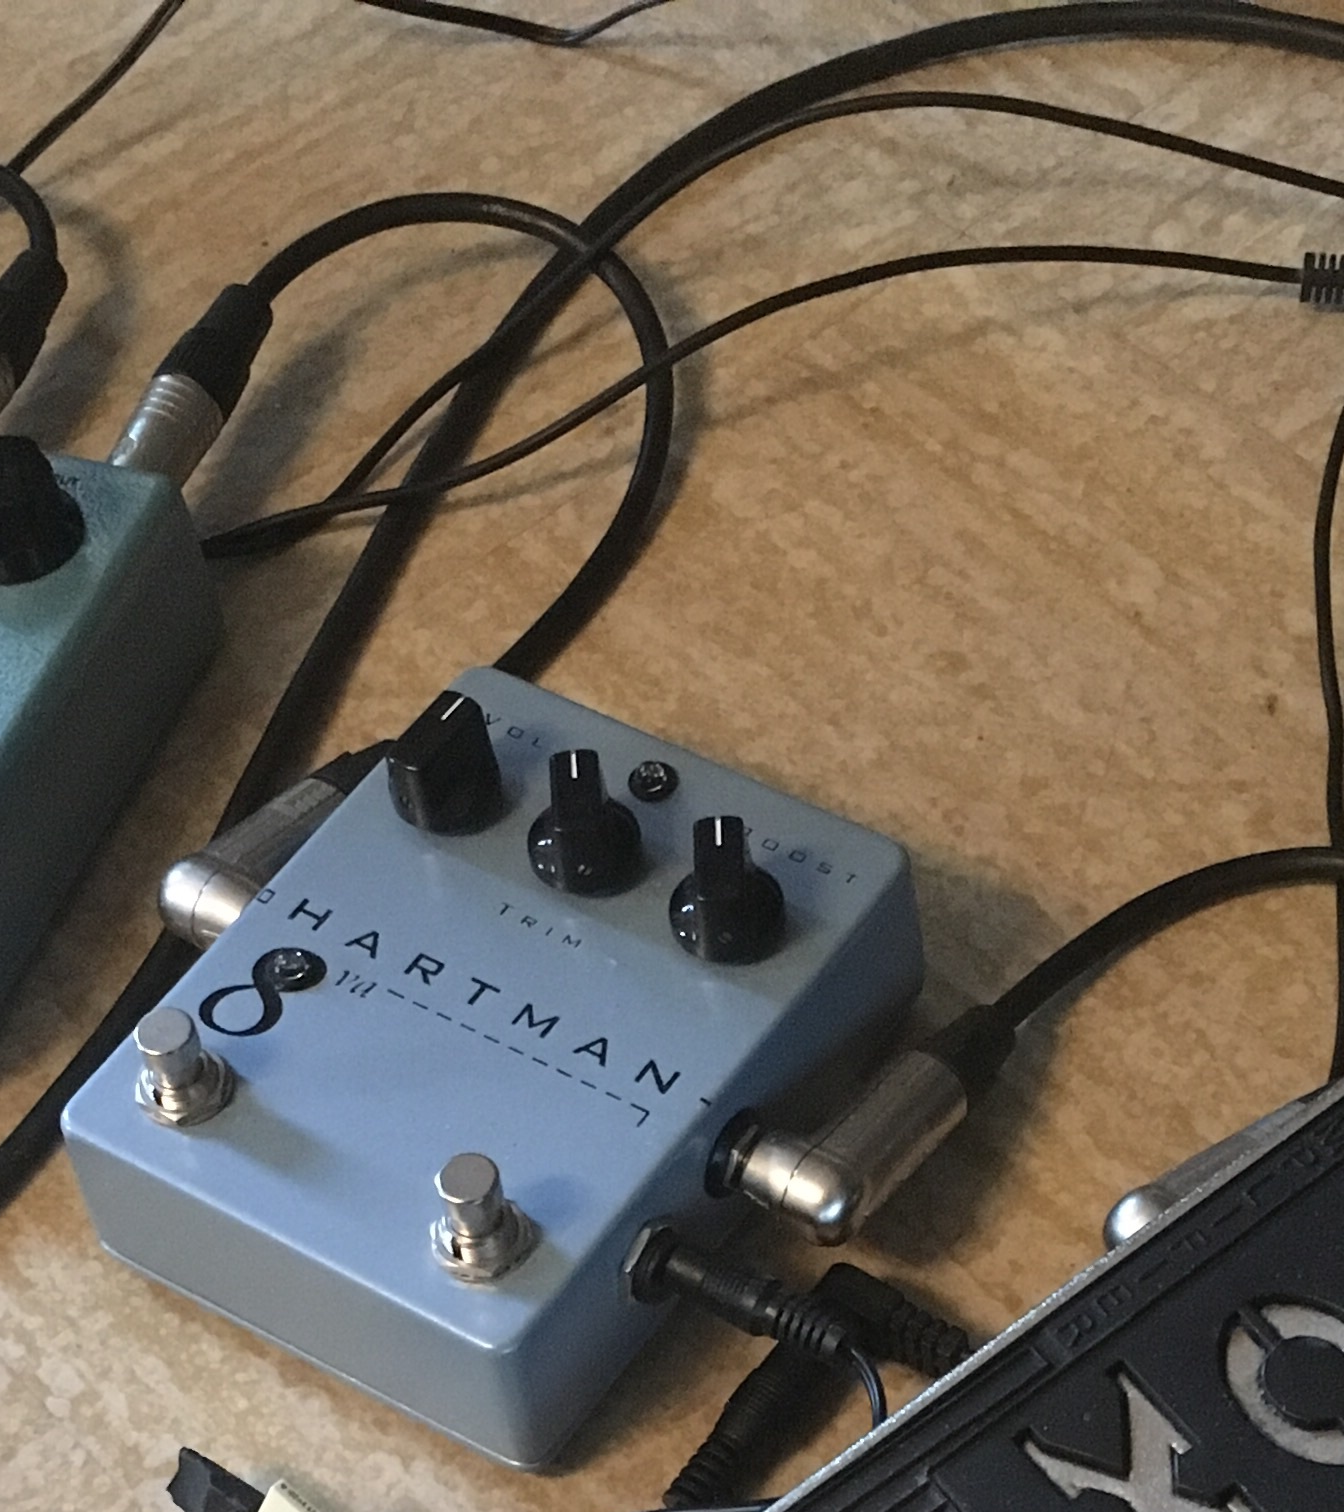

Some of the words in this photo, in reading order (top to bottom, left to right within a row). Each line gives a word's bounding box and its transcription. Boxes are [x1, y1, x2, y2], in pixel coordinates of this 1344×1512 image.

[484, 712, 543, 749] VOL
[498, 902, 583, 948] TRIM
[287, 898, 681, 1095] HARTMAN
